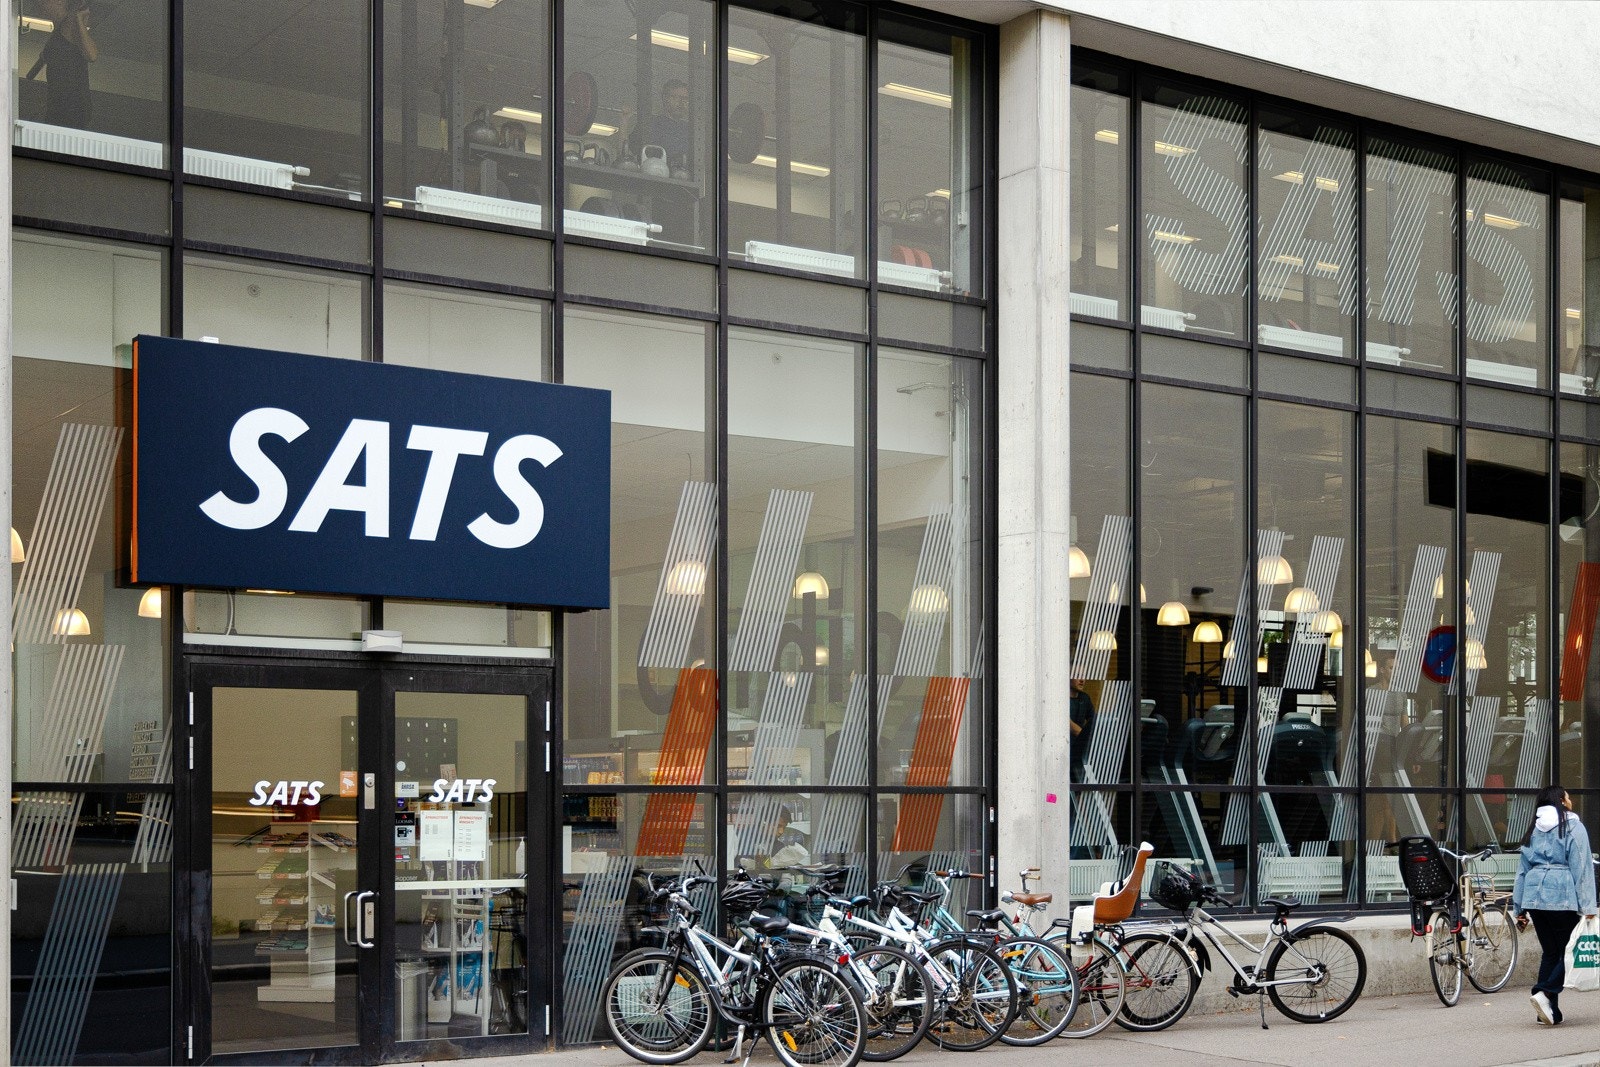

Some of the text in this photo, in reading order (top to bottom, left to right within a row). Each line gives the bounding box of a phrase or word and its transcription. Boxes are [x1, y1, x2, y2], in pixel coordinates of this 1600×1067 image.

[1145, 96, 1539, 344] SATS
[199, 407, 563, 549] SATS
[249, 780, 325, 806] SATS
[428, 779, 497, 802] SATS
